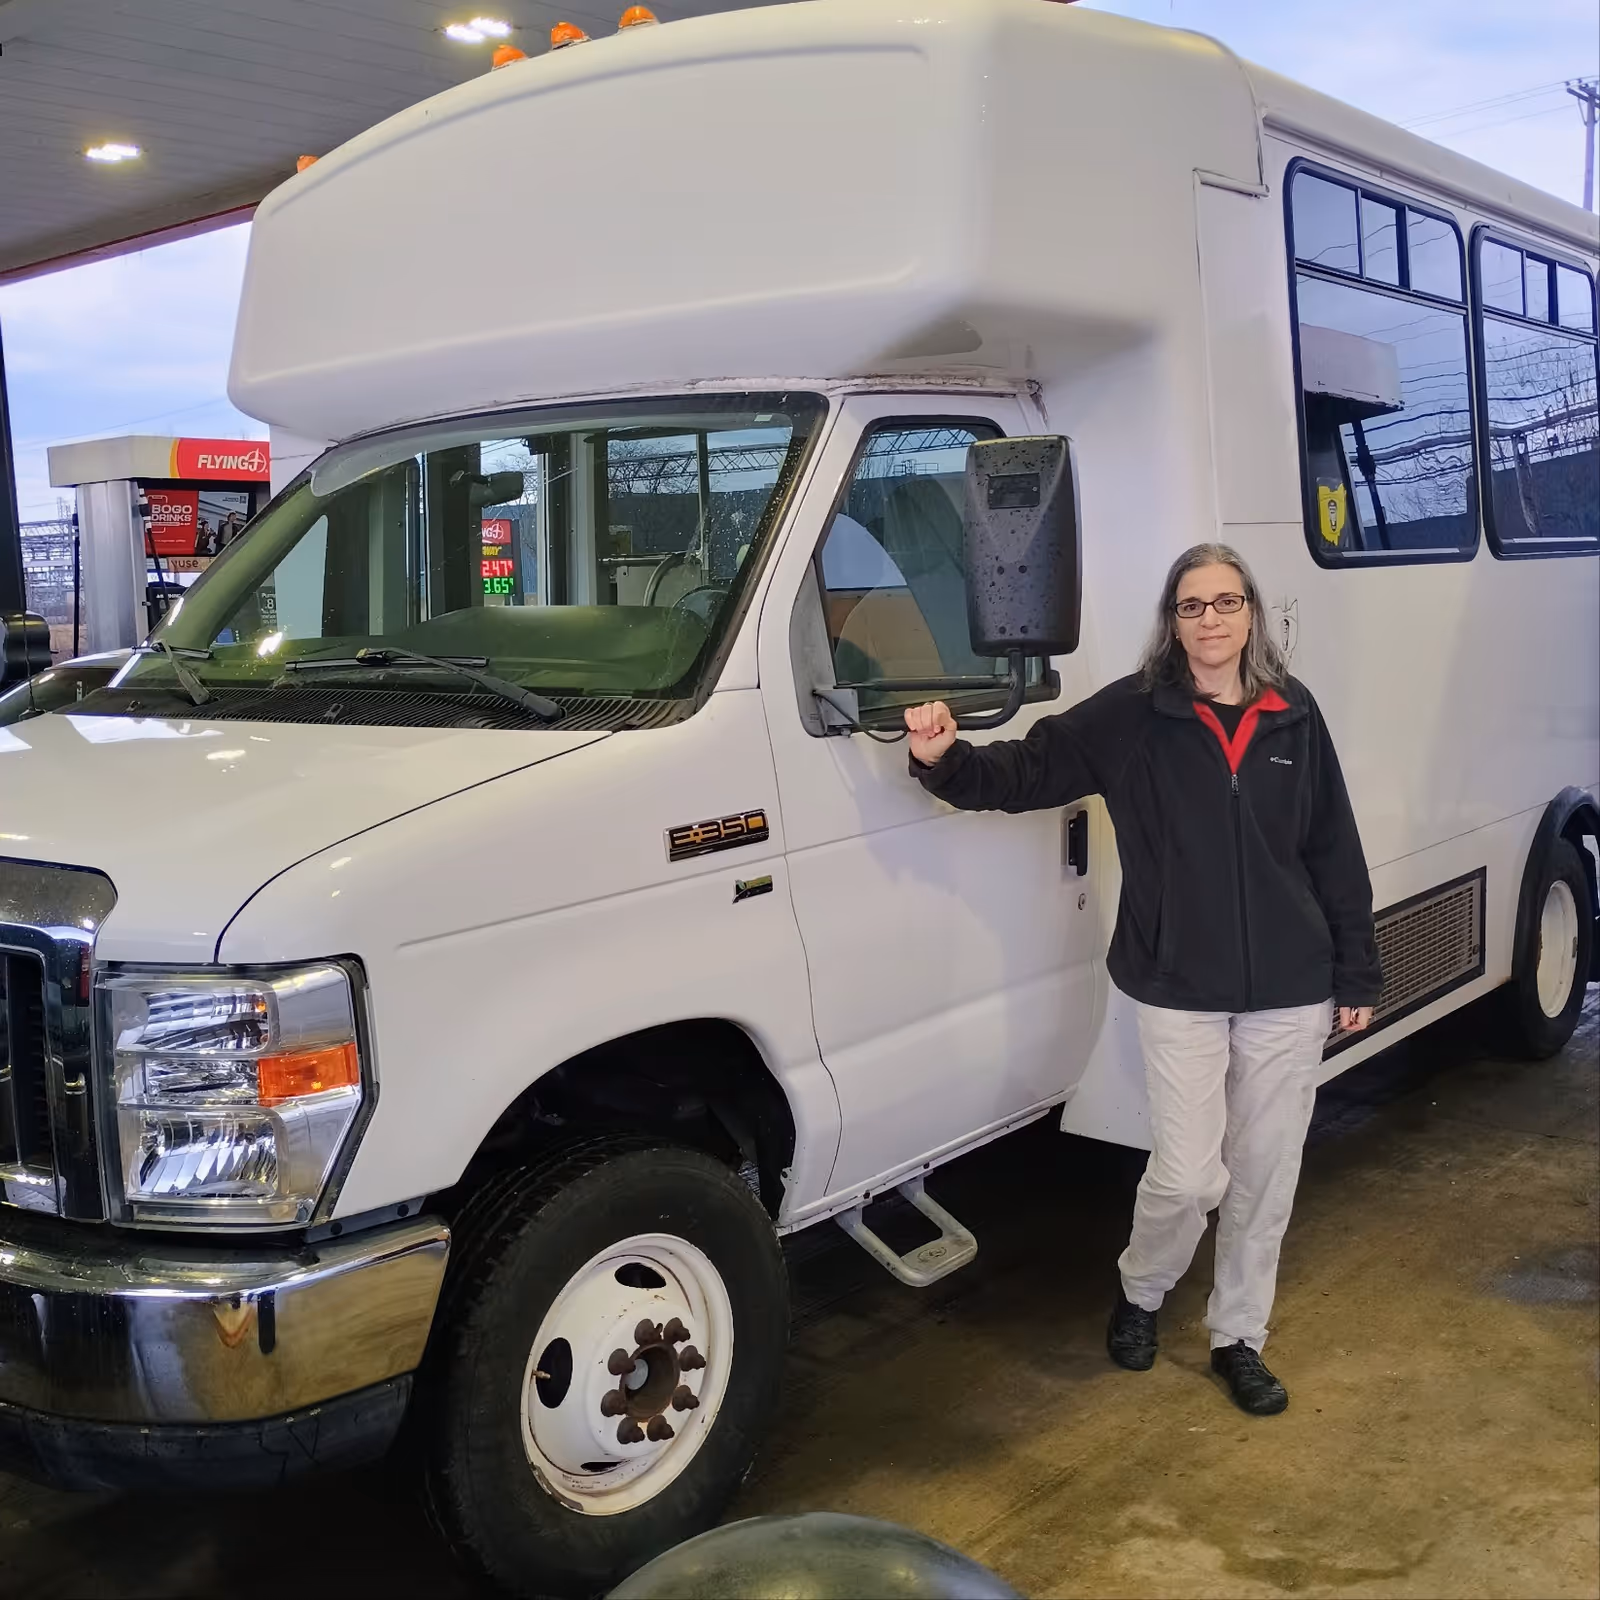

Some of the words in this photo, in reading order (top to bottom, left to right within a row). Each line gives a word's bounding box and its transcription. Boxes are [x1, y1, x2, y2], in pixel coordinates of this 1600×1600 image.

[152, 504, 192, 514] BOGO
[151, 513, 192, 522] DRINKS
[267, 598, 274, 609] 8
[669, 811, 767, 849] E-350
